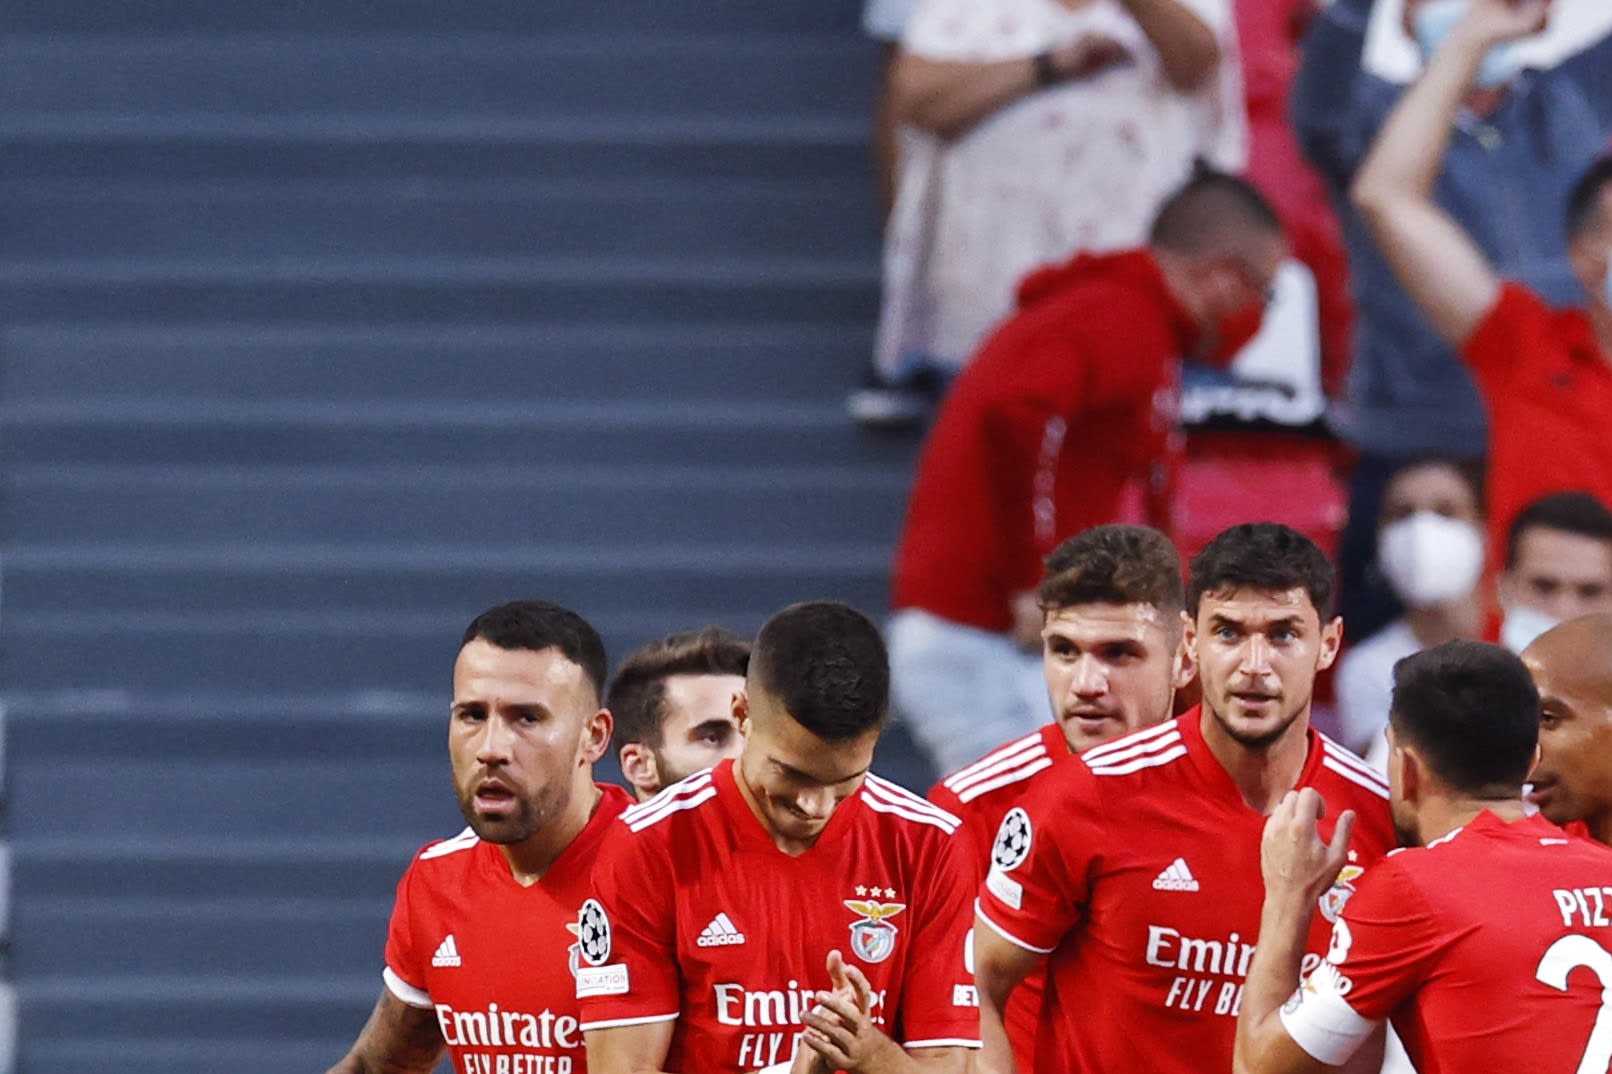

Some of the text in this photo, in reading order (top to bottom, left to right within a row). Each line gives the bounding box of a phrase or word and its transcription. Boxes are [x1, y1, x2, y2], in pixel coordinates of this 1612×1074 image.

[1152, 879, 1200, 892] adidas
[697, 932, 745, 946] adidas
[1164, 977, 1213, 1012] FLY
[434, 1002, 587, 1049] Emirate
[738, 1032, 784, 1067] FLY
